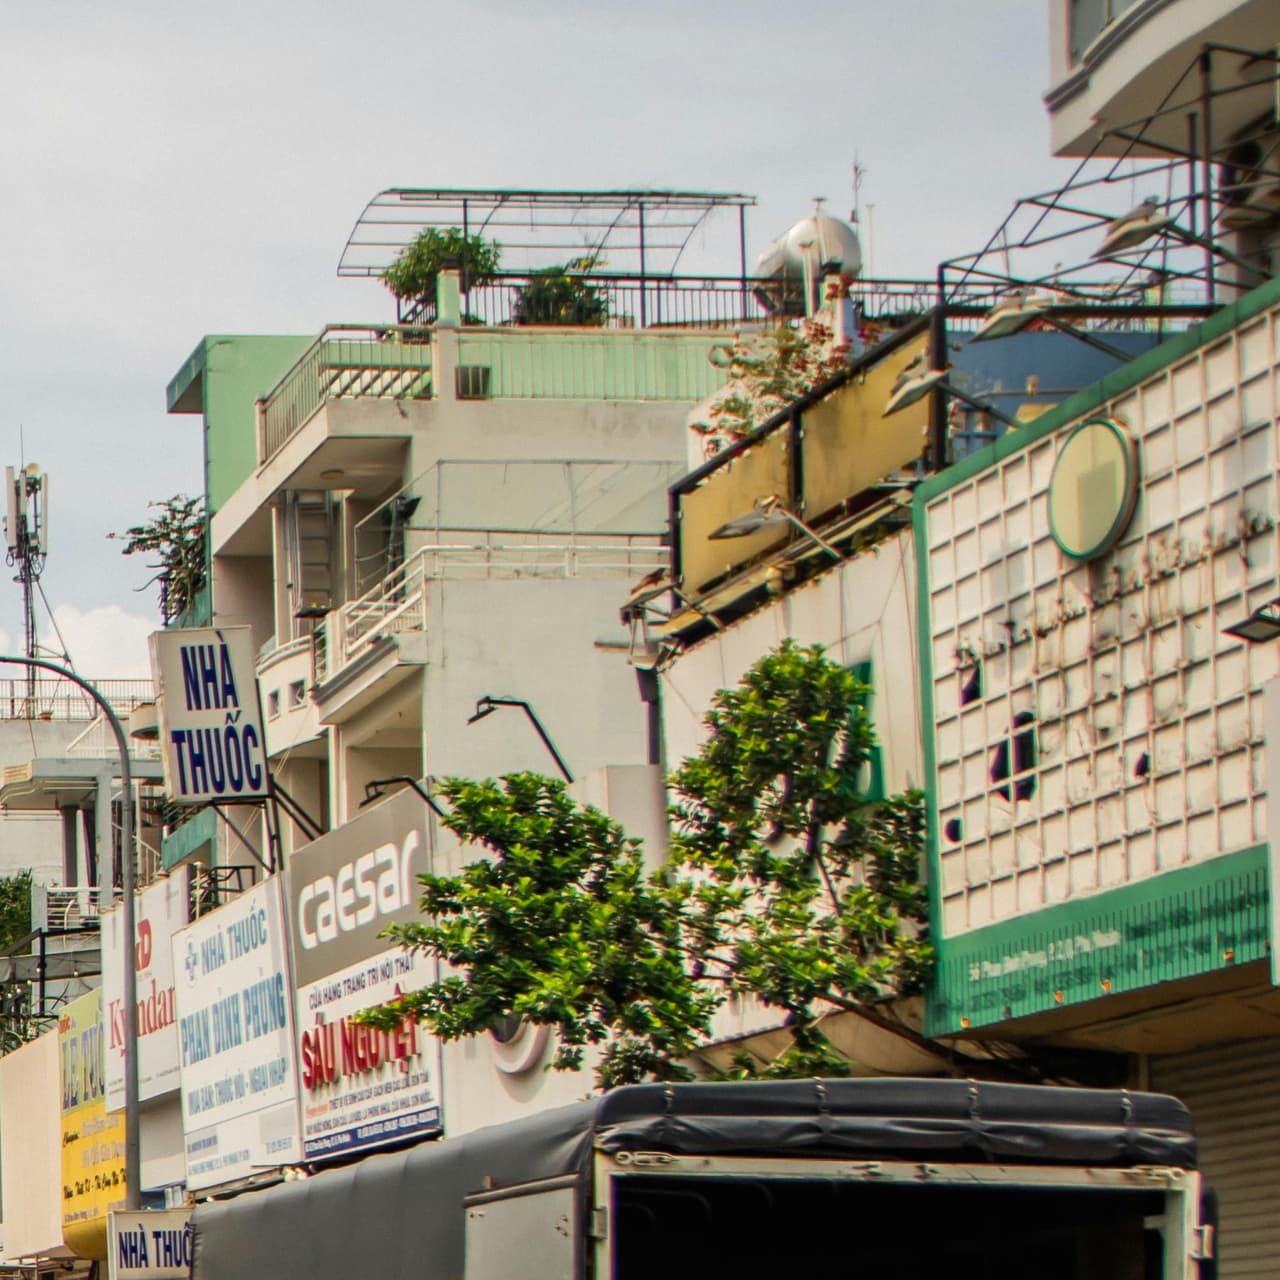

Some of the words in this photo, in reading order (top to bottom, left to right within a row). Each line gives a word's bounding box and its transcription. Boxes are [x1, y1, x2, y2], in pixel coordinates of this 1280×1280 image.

[180, 630, 239, 711] NHÀ
[171, 710, 262, 795] THUỐC
[298, 829, 419, 950] caesar
[200, 924, 226, 976] NHÀ
[226, 898, 268, 962] THUỐC
[180, 1006, 212, 1068] PHAN
[118, 1222, 150, 1269] NHÀ
